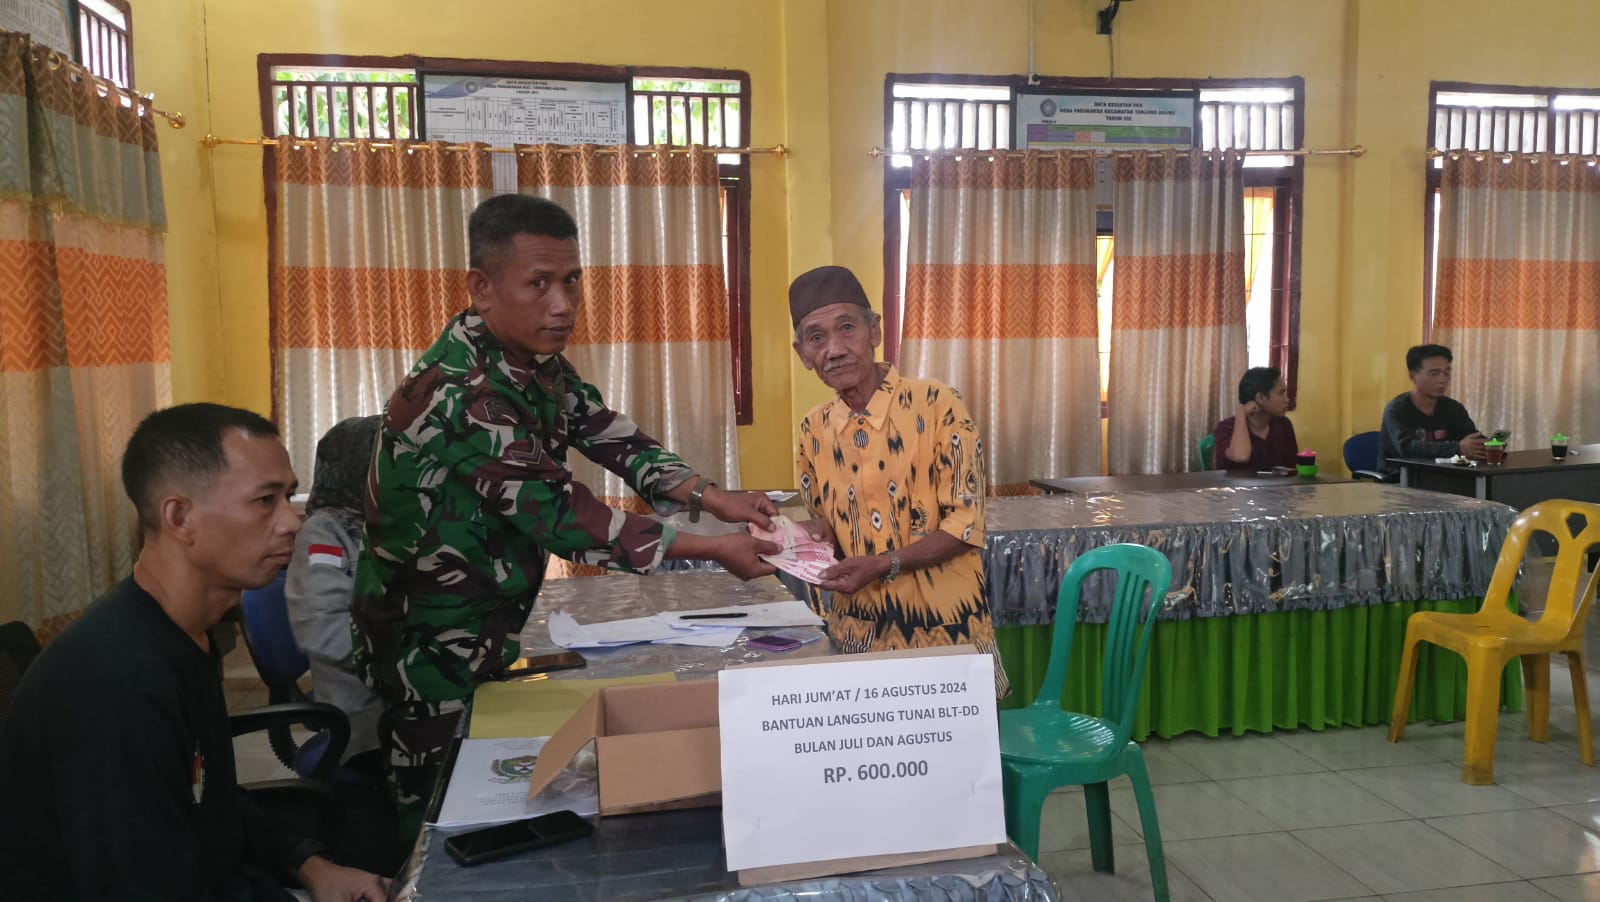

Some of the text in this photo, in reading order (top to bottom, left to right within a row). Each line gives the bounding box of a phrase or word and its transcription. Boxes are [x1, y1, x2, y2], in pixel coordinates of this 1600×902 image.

[771, 693, 802, 706] HARI
[854, 688, 861, 702] /
[864, 687, 879, 699] 16
[881, 684, 937, 699] AGUSTUS
[939, 681, 968, 694] 2024
[762, 705, 980, 732] BANTUAN LANGSUNG TUNAI BLT-DD
[794, 731, 953, 754] BULAN JULI DAN AGUSTUS
[823, 759, 929, 784] RP. 600.000
